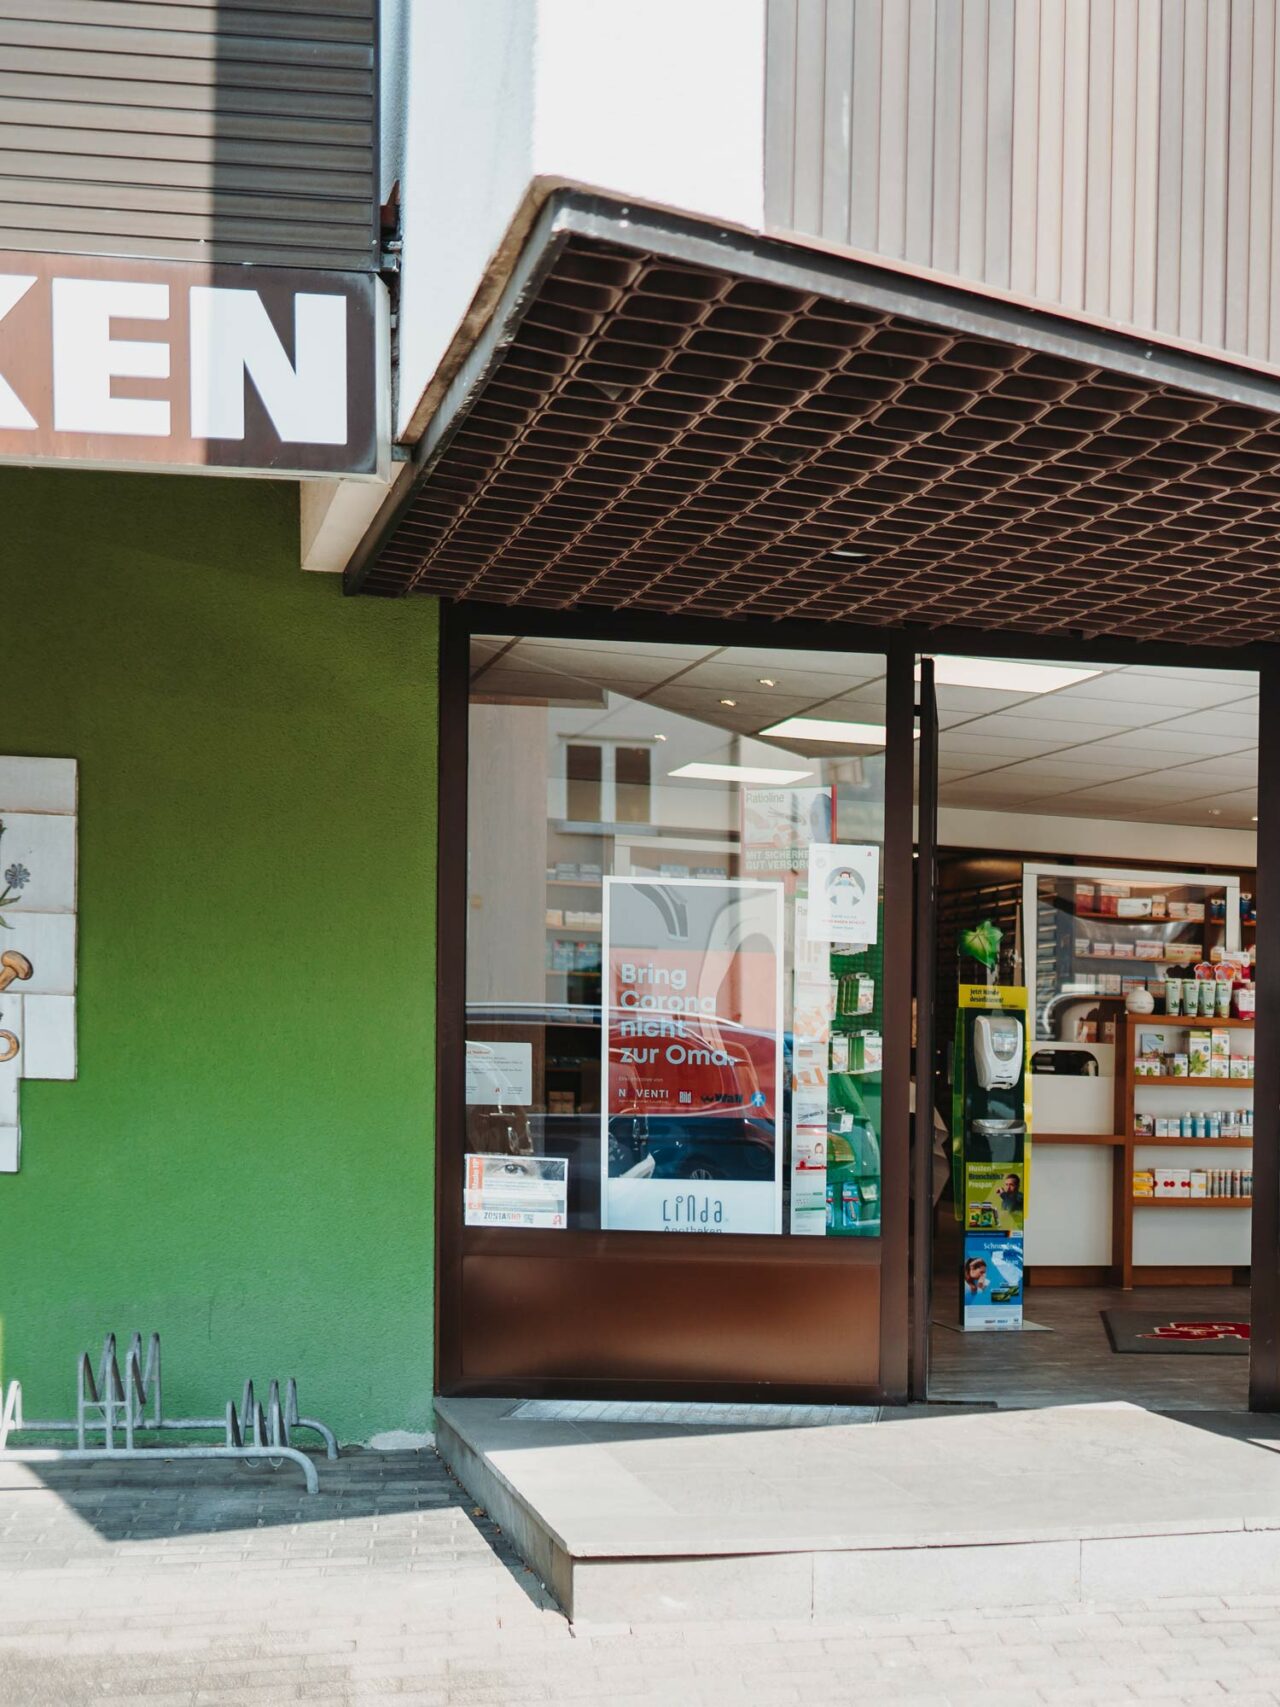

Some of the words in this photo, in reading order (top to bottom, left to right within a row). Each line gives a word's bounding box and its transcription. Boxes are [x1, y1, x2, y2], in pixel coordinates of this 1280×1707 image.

[0, 274, 348, 444] EN
[621, 963, 687, 990] Bring
[620, 990, 717, 1013] Corona
[620, 1016, 688, 1038] nicht
[620, 1047, 660, 1064] zur
[665, 1044, 735, 1066] Oma.
[618, 1088, 669, 1098] NVENTI
